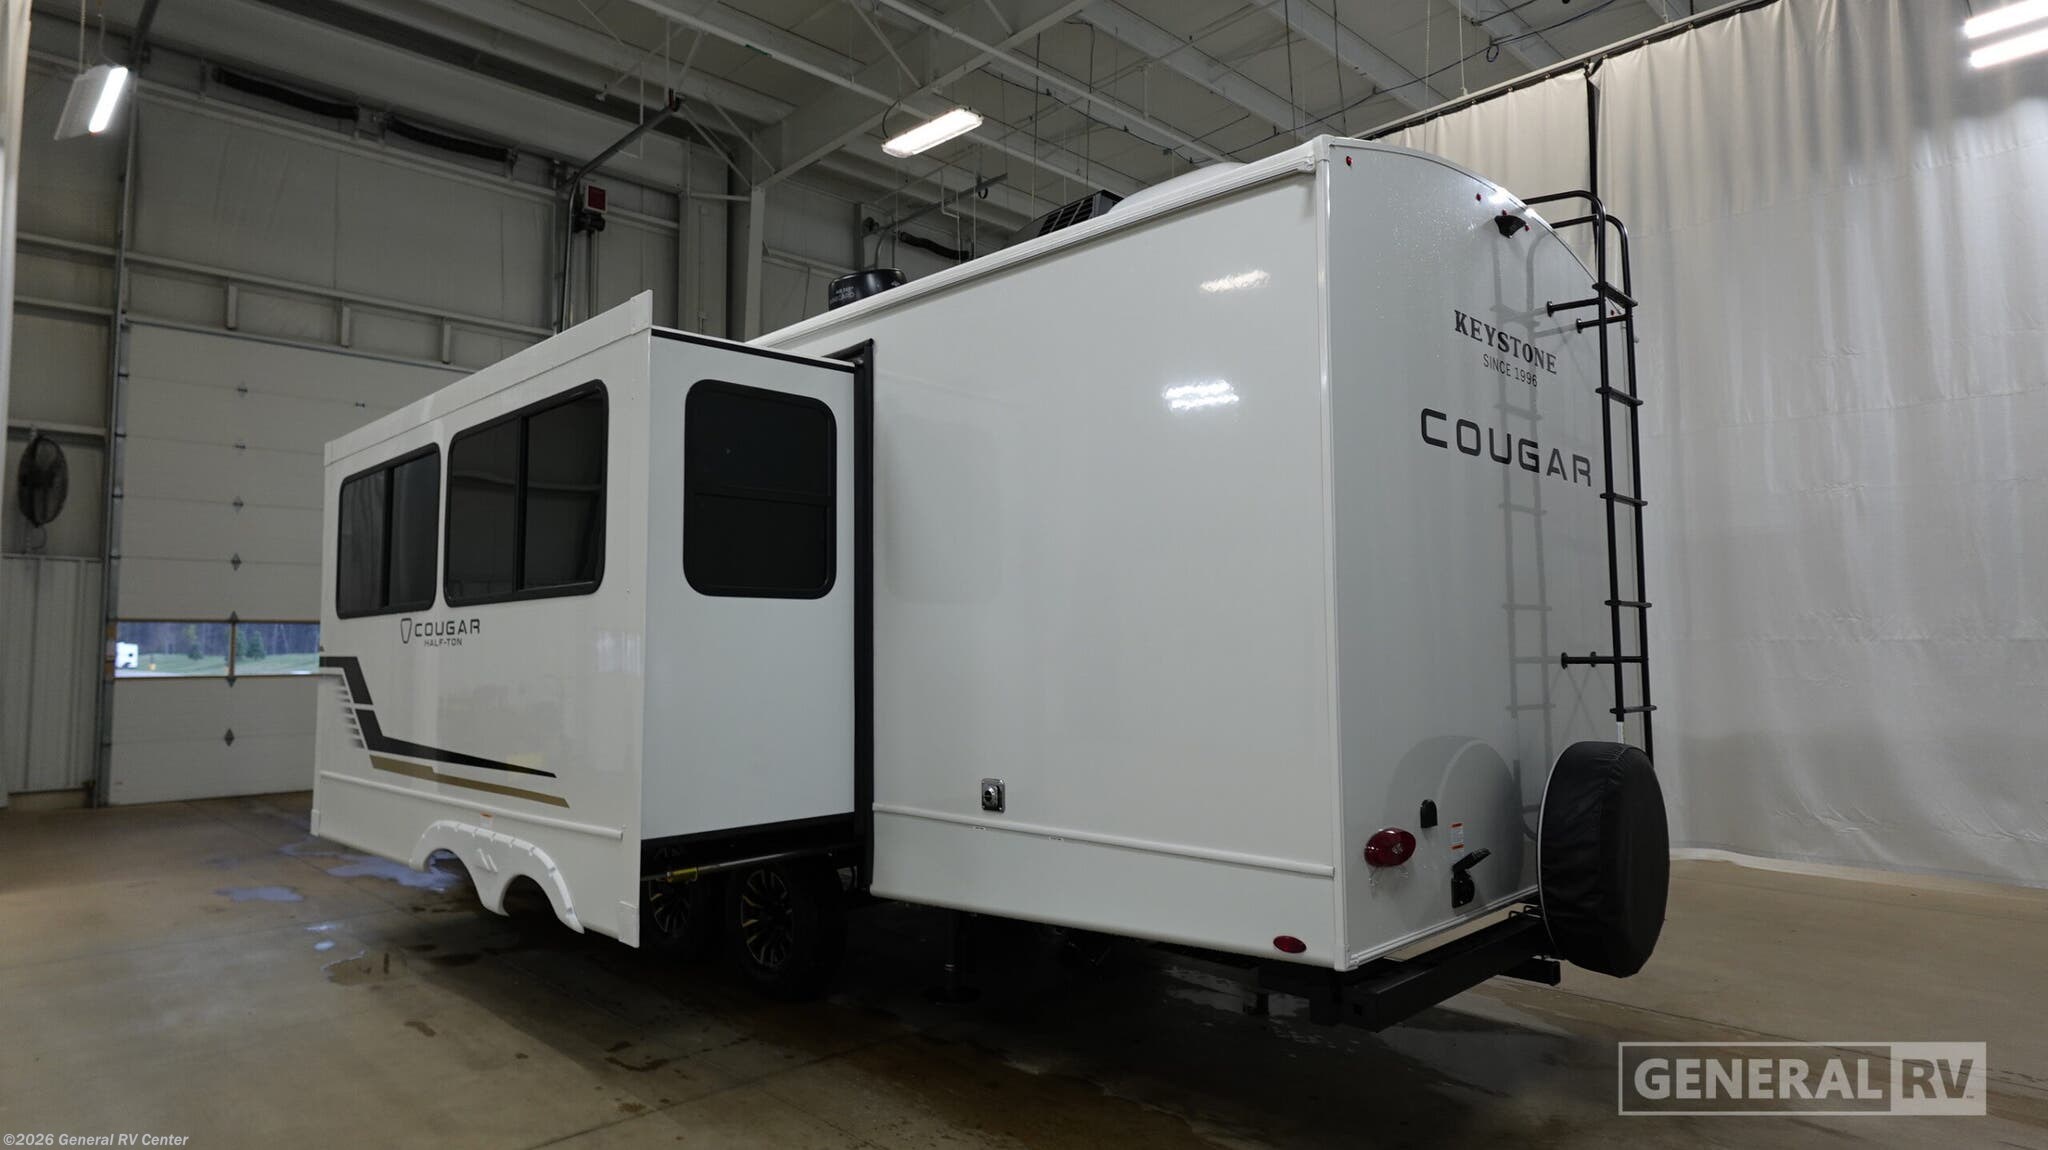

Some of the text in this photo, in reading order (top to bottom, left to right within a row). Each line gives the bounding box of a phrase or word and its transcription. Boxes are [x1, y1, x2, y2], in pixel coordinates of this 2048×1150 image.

[1454, 309, 1557, 375] KEYSTONE
[1483, 353, 1538, 388] SINCE 1996
[1421, 408, 1592, 487] COUGAR
[415, 618, 480, 637] COUGAR
[424, 638, 463, 647] HALF-TON
